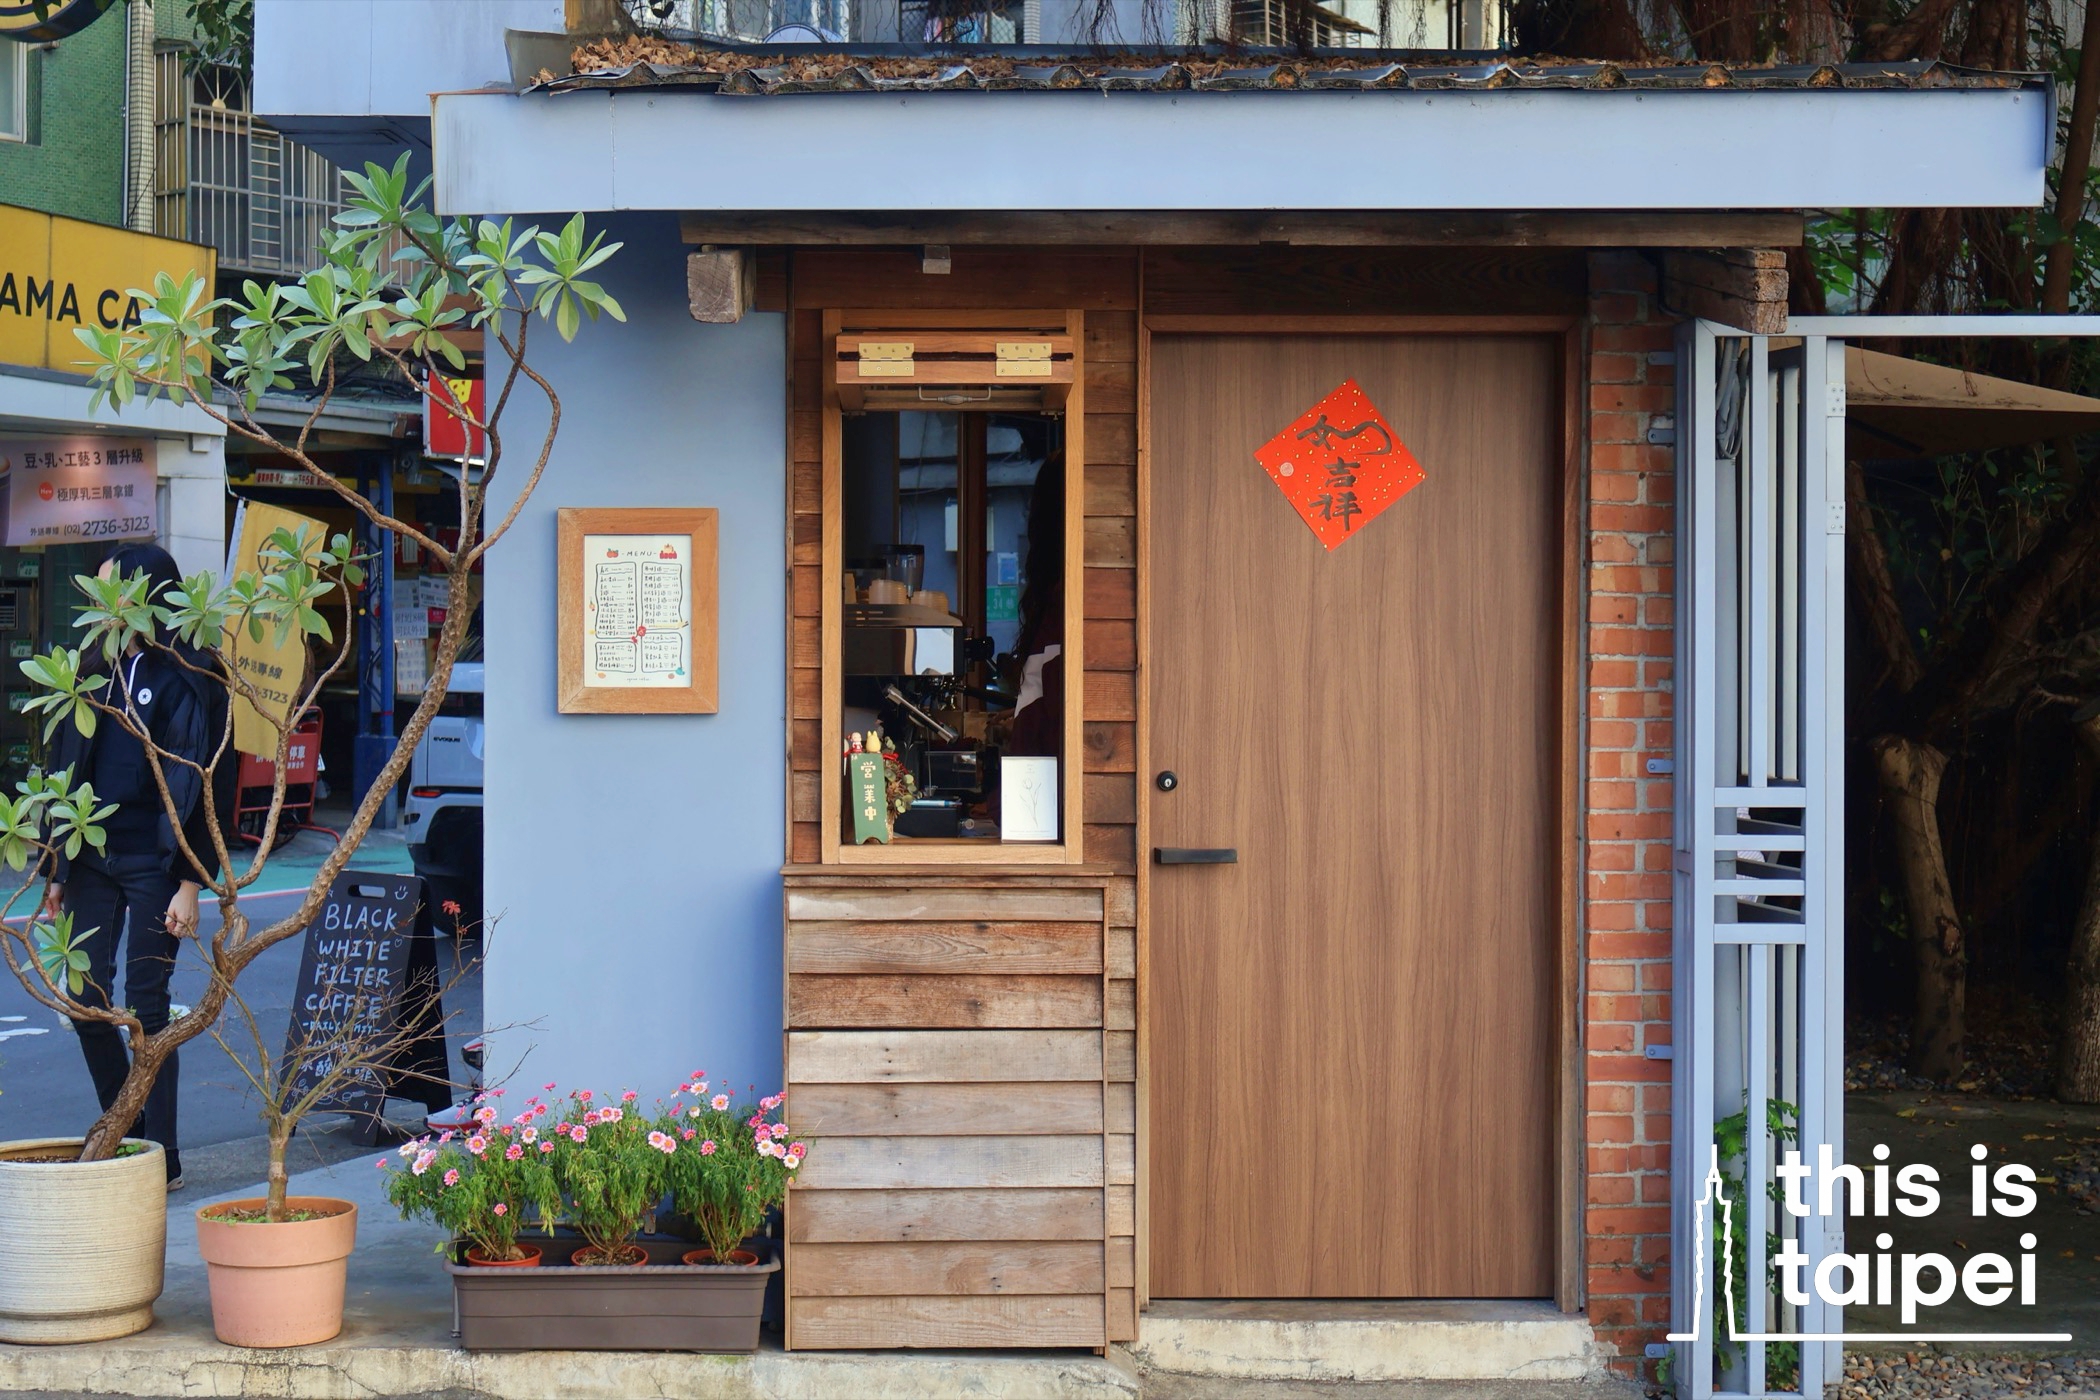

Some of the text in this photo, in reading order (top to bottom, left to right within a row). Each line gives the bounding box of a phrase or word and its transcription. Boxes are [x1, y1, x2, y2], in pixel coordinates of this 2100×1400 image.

[63, 524, 81, 535] (02)
[81, 516, 150, 537] 2736-3123
[324, 903, 398, 932] BLACK
[318, 939, 391, 961] WHITE
[314, 962, 391, 988] FILTER
